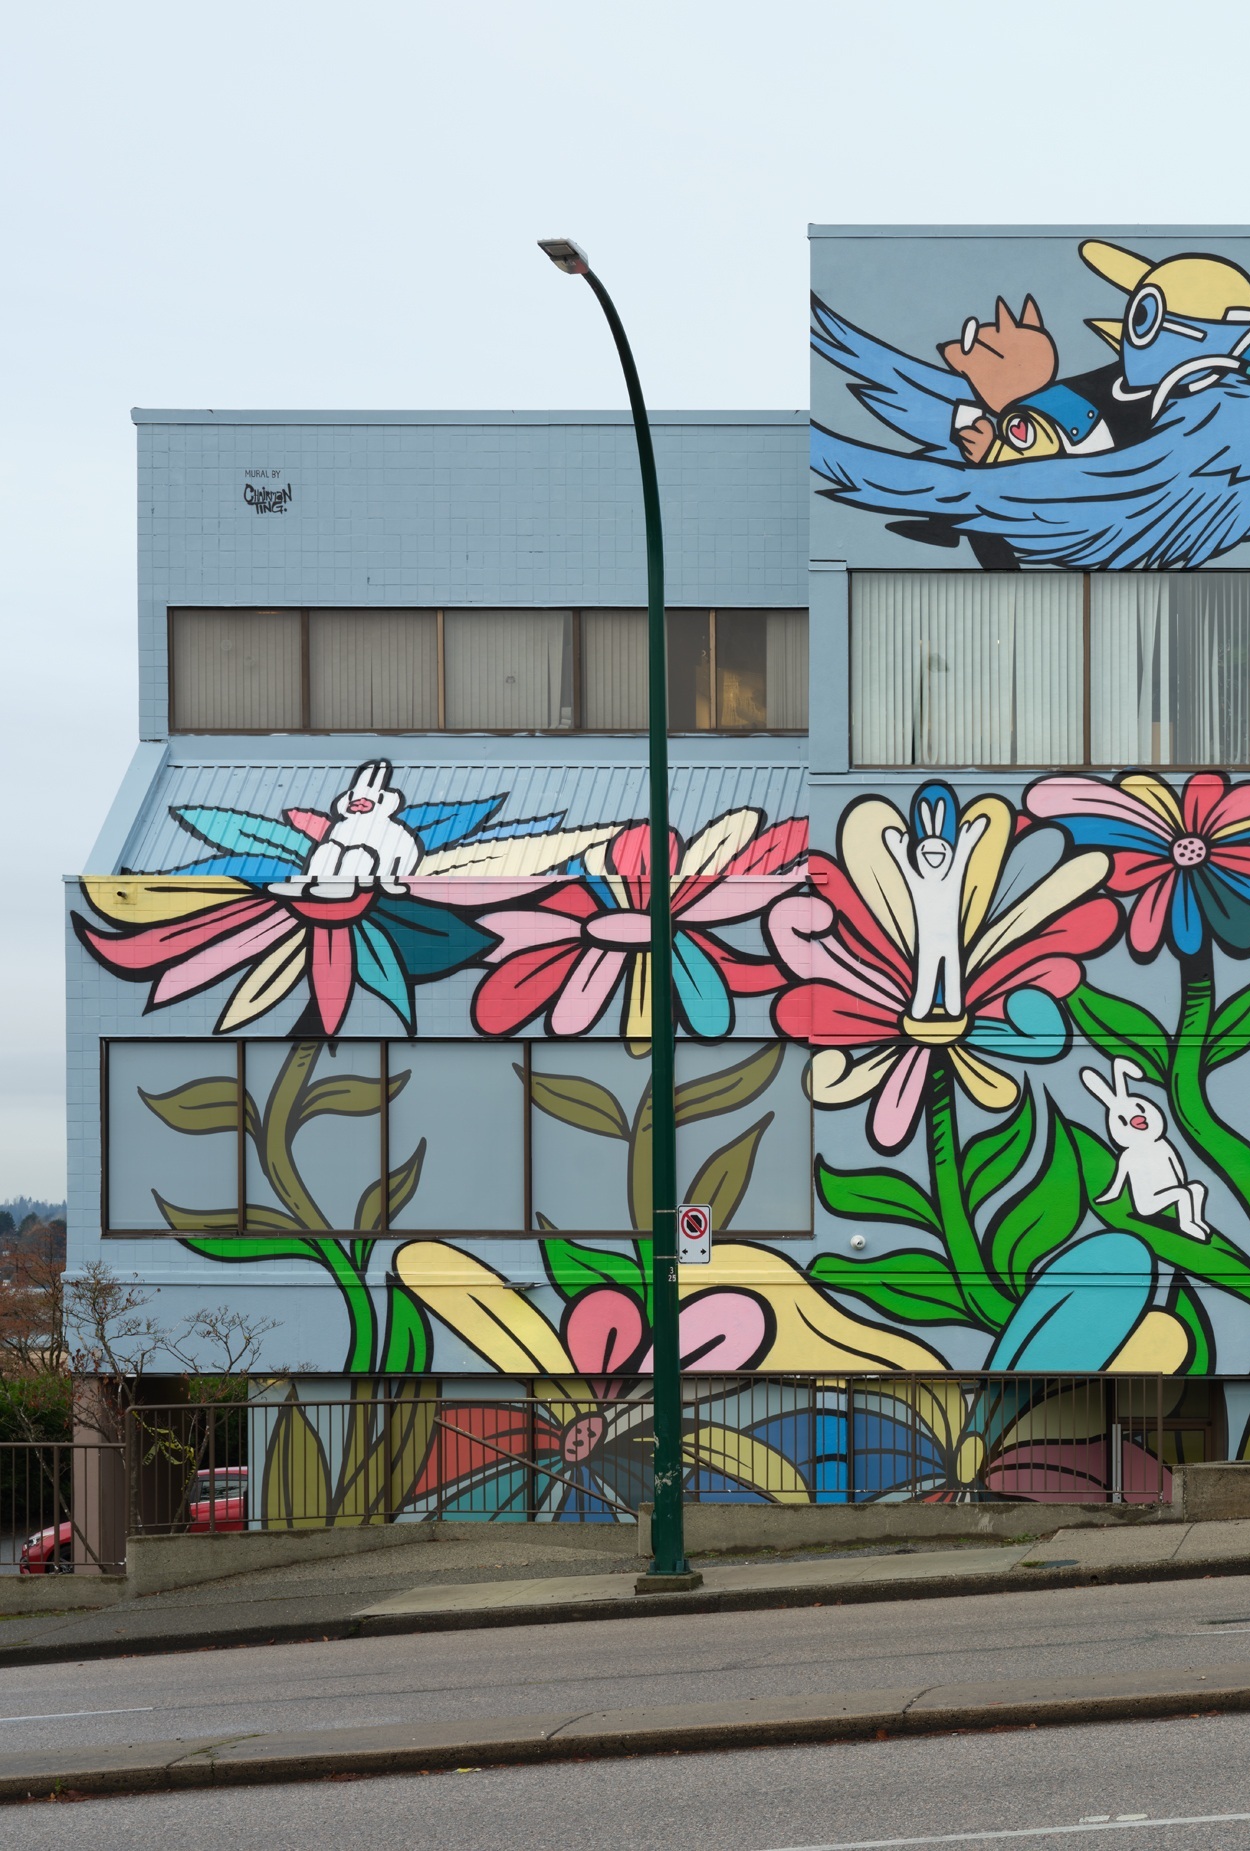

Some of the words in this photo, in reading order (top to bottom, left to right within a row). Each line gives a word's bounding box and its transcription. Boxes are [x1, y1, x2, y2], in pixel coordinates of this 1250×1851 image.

[245, 470, 270, 478] MURAL
[272, 470, 281, 478] BY
[669, 1266, 674, 1274] 3
[668, 1274, 677, 1282] 25
